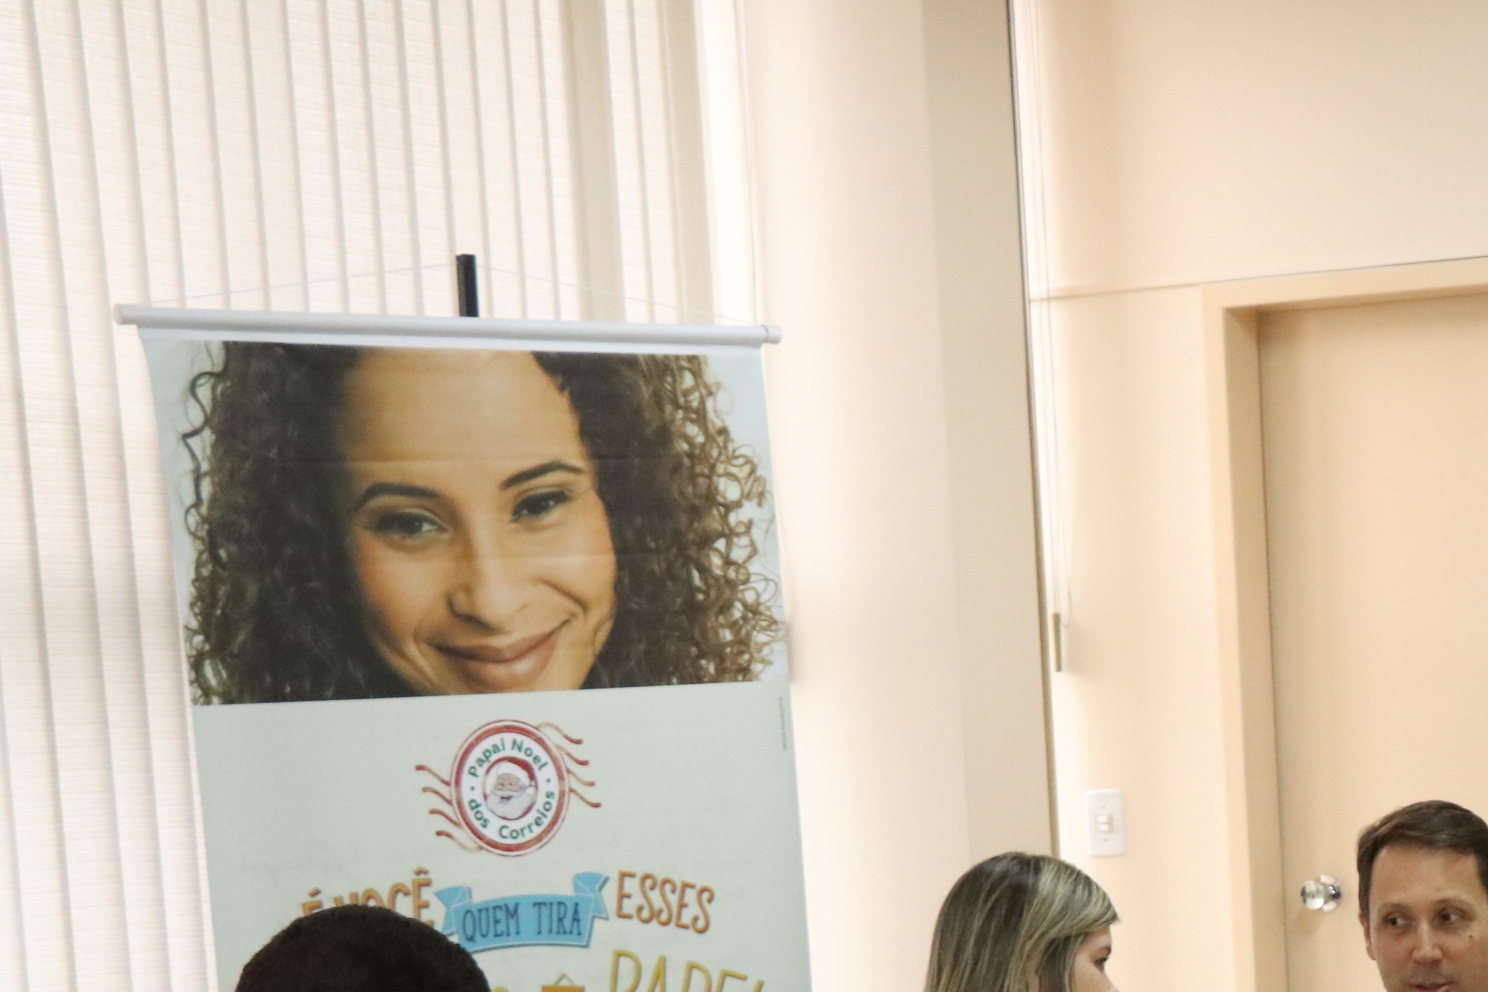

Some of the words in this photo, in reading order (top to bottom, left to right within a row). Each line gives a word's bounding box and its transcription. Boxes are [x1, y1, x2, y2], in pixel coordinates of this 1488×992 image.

[467, 738, 506, 778] Papai
[511, 738, 549, 771] Noel
[467, 798, 491, 829] dos
[498, 790, 556, 840] Correios
[332, 866, 434, 928] CÊ
[462, 902, 520, 943] QUEM
[532, 901, 583, 936] TIRA
[616, 870, 715, 934] ESSES
